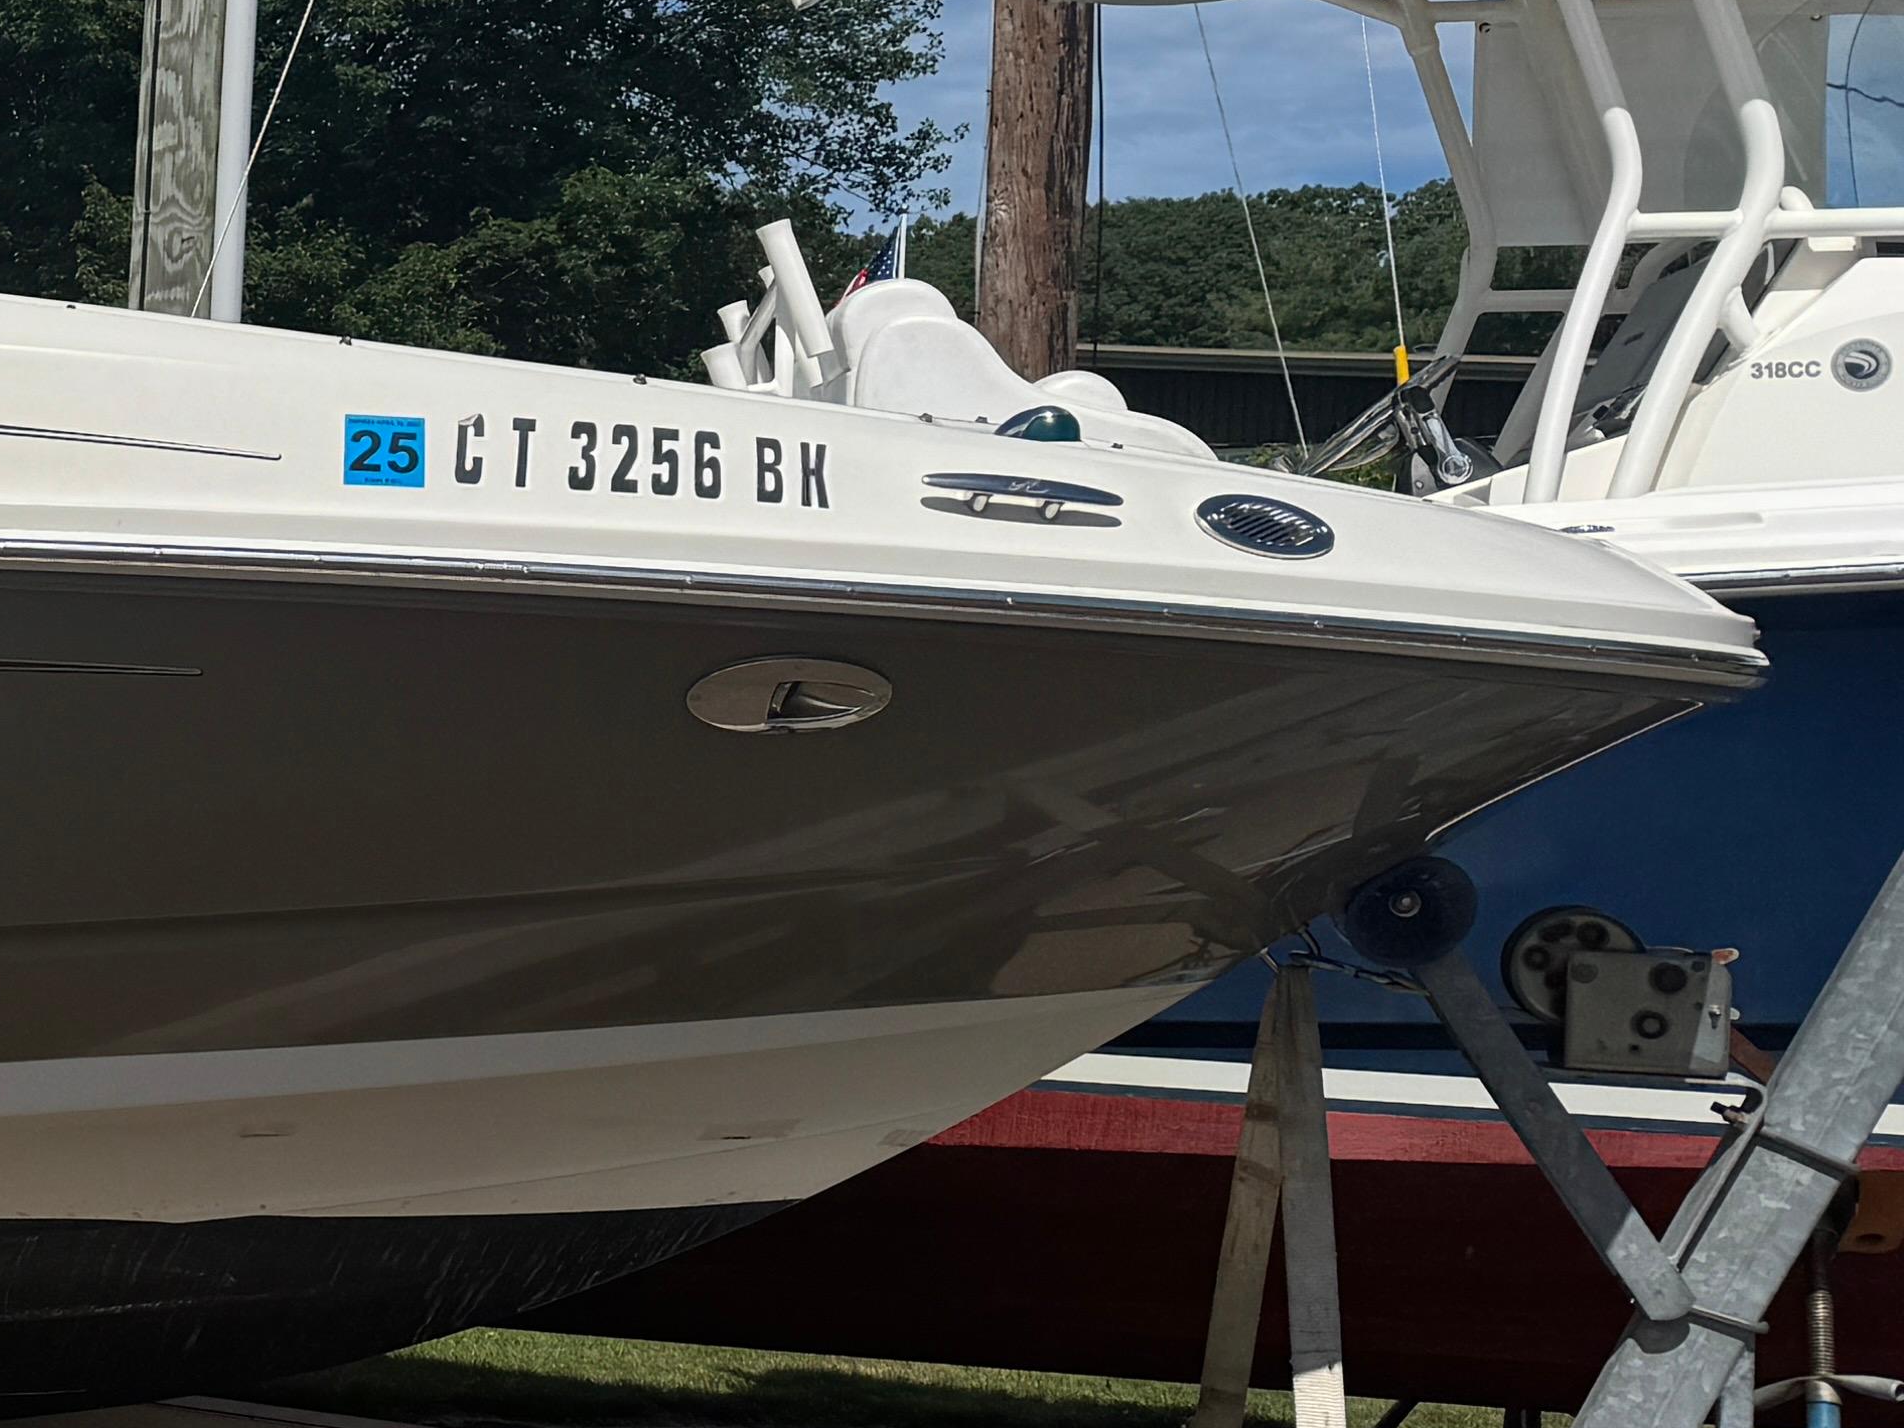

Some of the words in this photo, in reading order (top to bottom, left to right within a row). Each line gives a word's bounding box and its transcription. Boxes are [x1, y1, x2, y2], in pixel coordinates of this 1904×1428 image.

[1750, 360, 1822, 380] 318CC
[349, 429, 420, 474] 25
[568, 420, 721, 500] 3256
